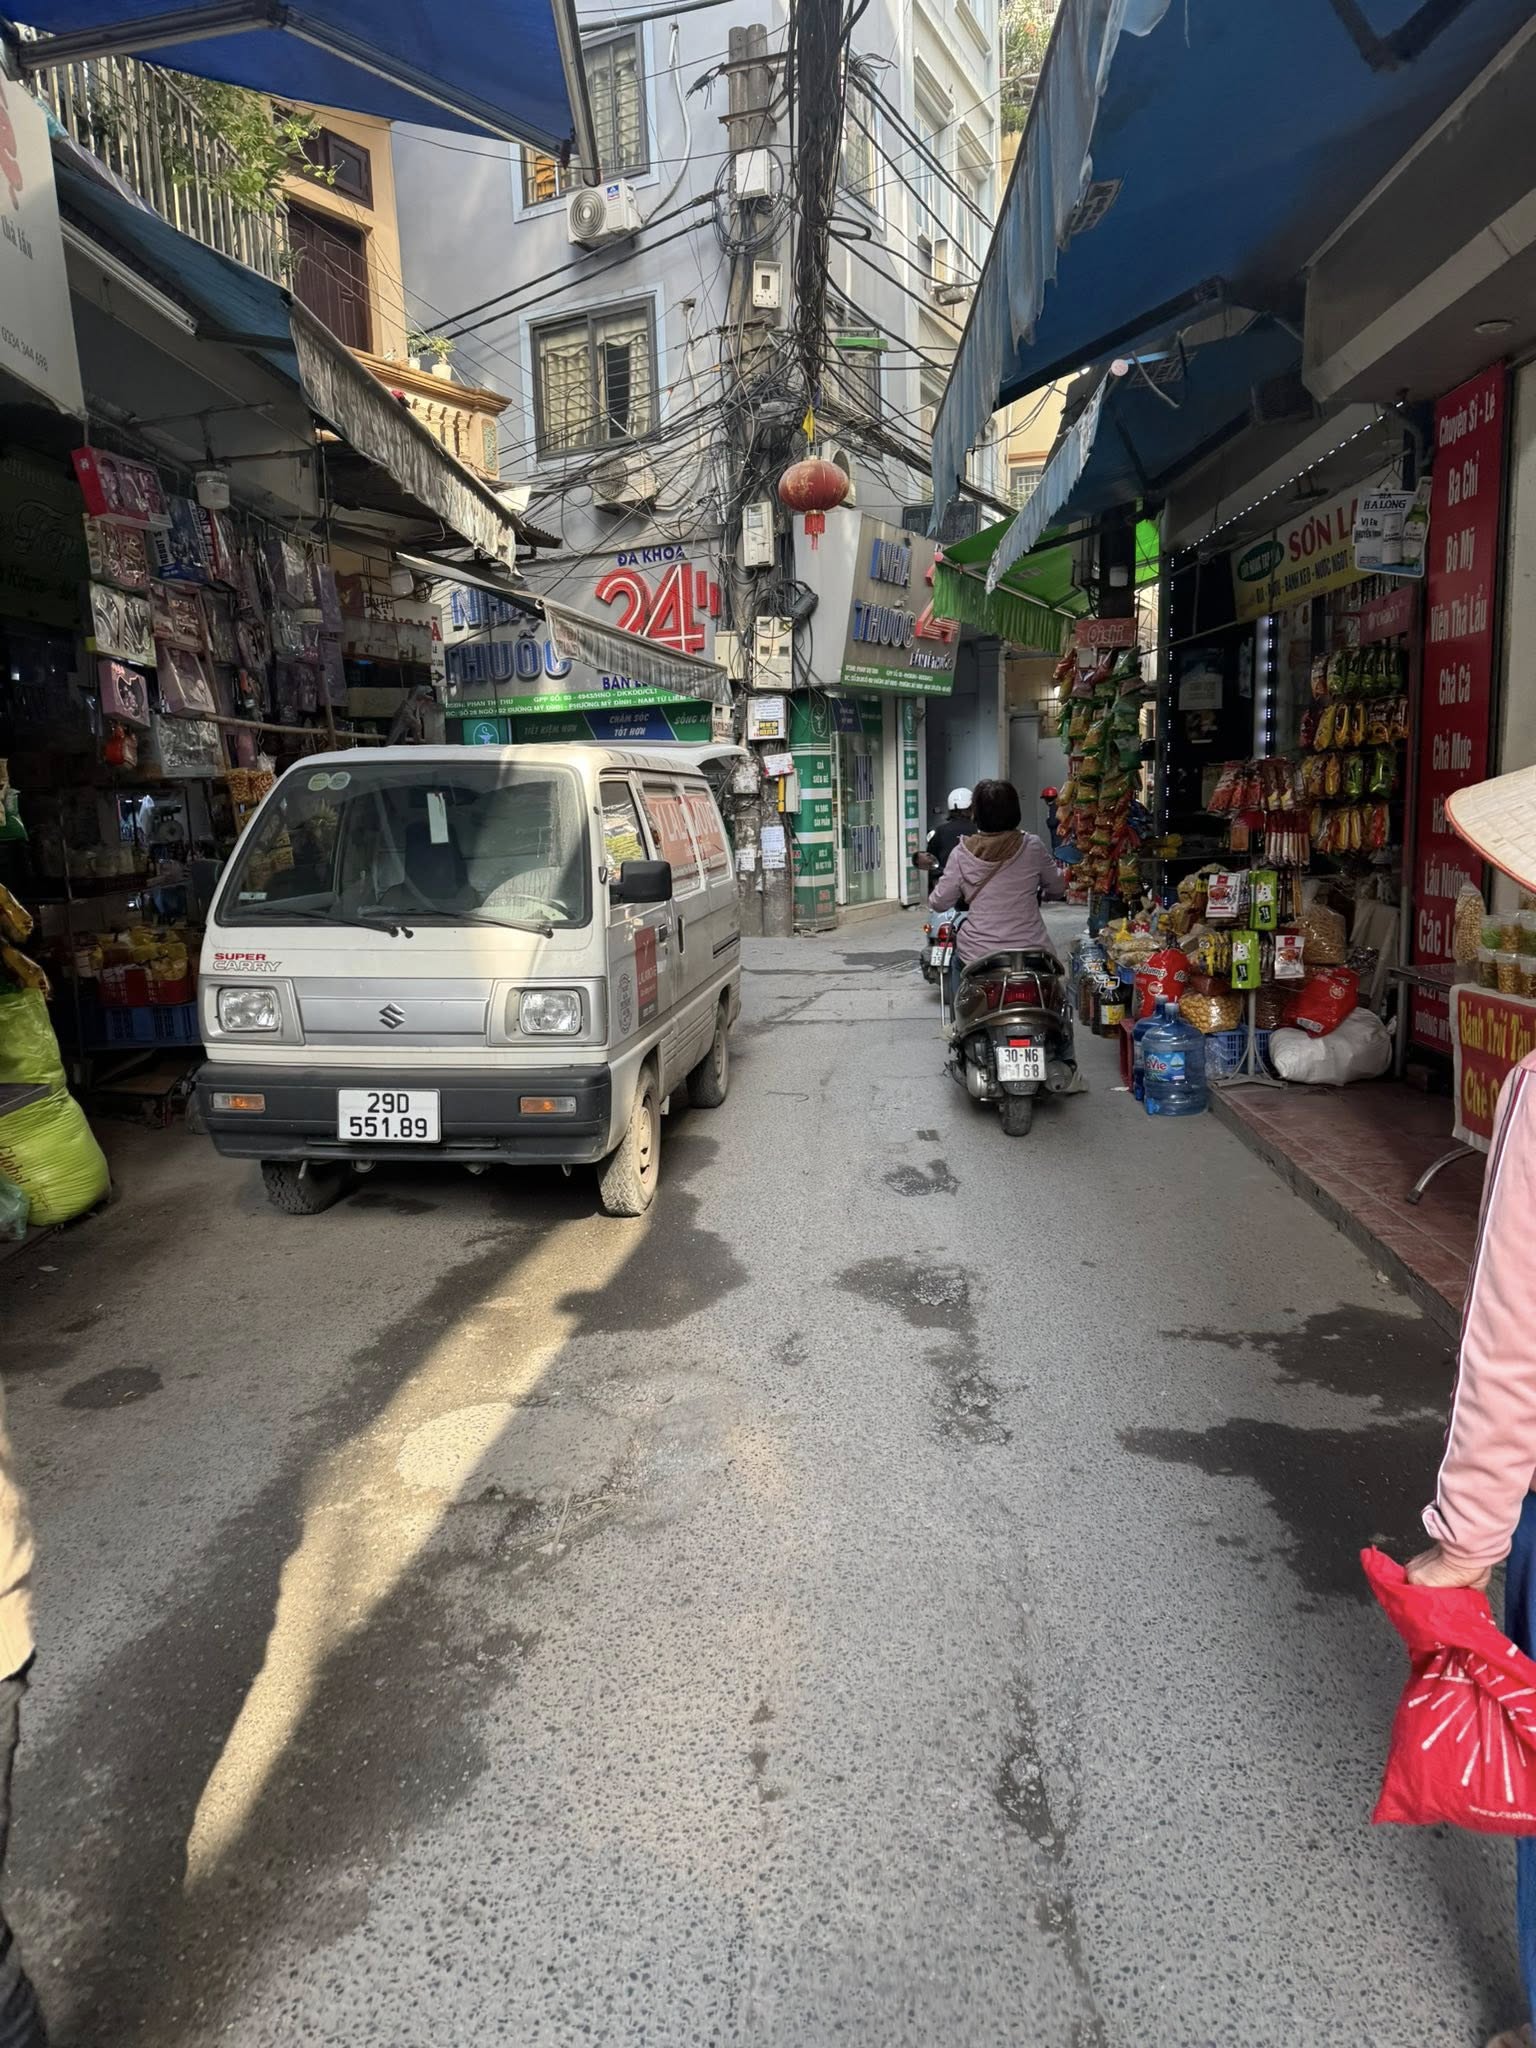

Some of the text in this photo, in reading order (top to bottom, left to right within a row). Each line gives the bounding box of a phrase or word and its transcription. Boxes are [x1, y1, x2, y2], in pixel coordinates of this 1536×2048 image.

[1439, 404, 1467, 448] Chuyên
[1447, 451, 1480, 506] Ba Chỉ
[1364, 500, 1407, 509] HALONG
[1288, 514, 1332, 562] SƠN
[617, 545, 688, 567] ĐA KHOA
[1445, 526, 1476, 573] Bò Mỹ
[1430, 604, 1449, 643] Viên
[1451, 592, 1467, 637] Thả
[1470, 583, 1488, 633] Lẩu
[1088, 624, 1124, 645] Oishi
[1438, 662, 1471, 706] Chả Cá
[569, 701, 599, 709] PHƯỜNG
[601, 698, 611, 706] MỸ
[668, 694, 687, 702] LIÊM
[633, 712, 650, 722] SÓC
[674, 711, 697, 725] SỐNG
[614, 726, 647, 737] TỐT HƠN
[1432, 729, 1472, 778] Chả Mực
[1424, 852, 1440, 897] Lẩu
[1418, 908, 1442, 957] Các
[213, 960, 282, 972] CARRY
[214, 953, 266, 961] SUPER
[1460, 1001, 1484, 1049] Bánh
[1004, 1048, 1038, 1062] 30-N6
[367, 1092, 409, 1114] 29D
[1464, 1066, 1487, 1120] Chè
[350, 1116, 427, 1138] 551.89
